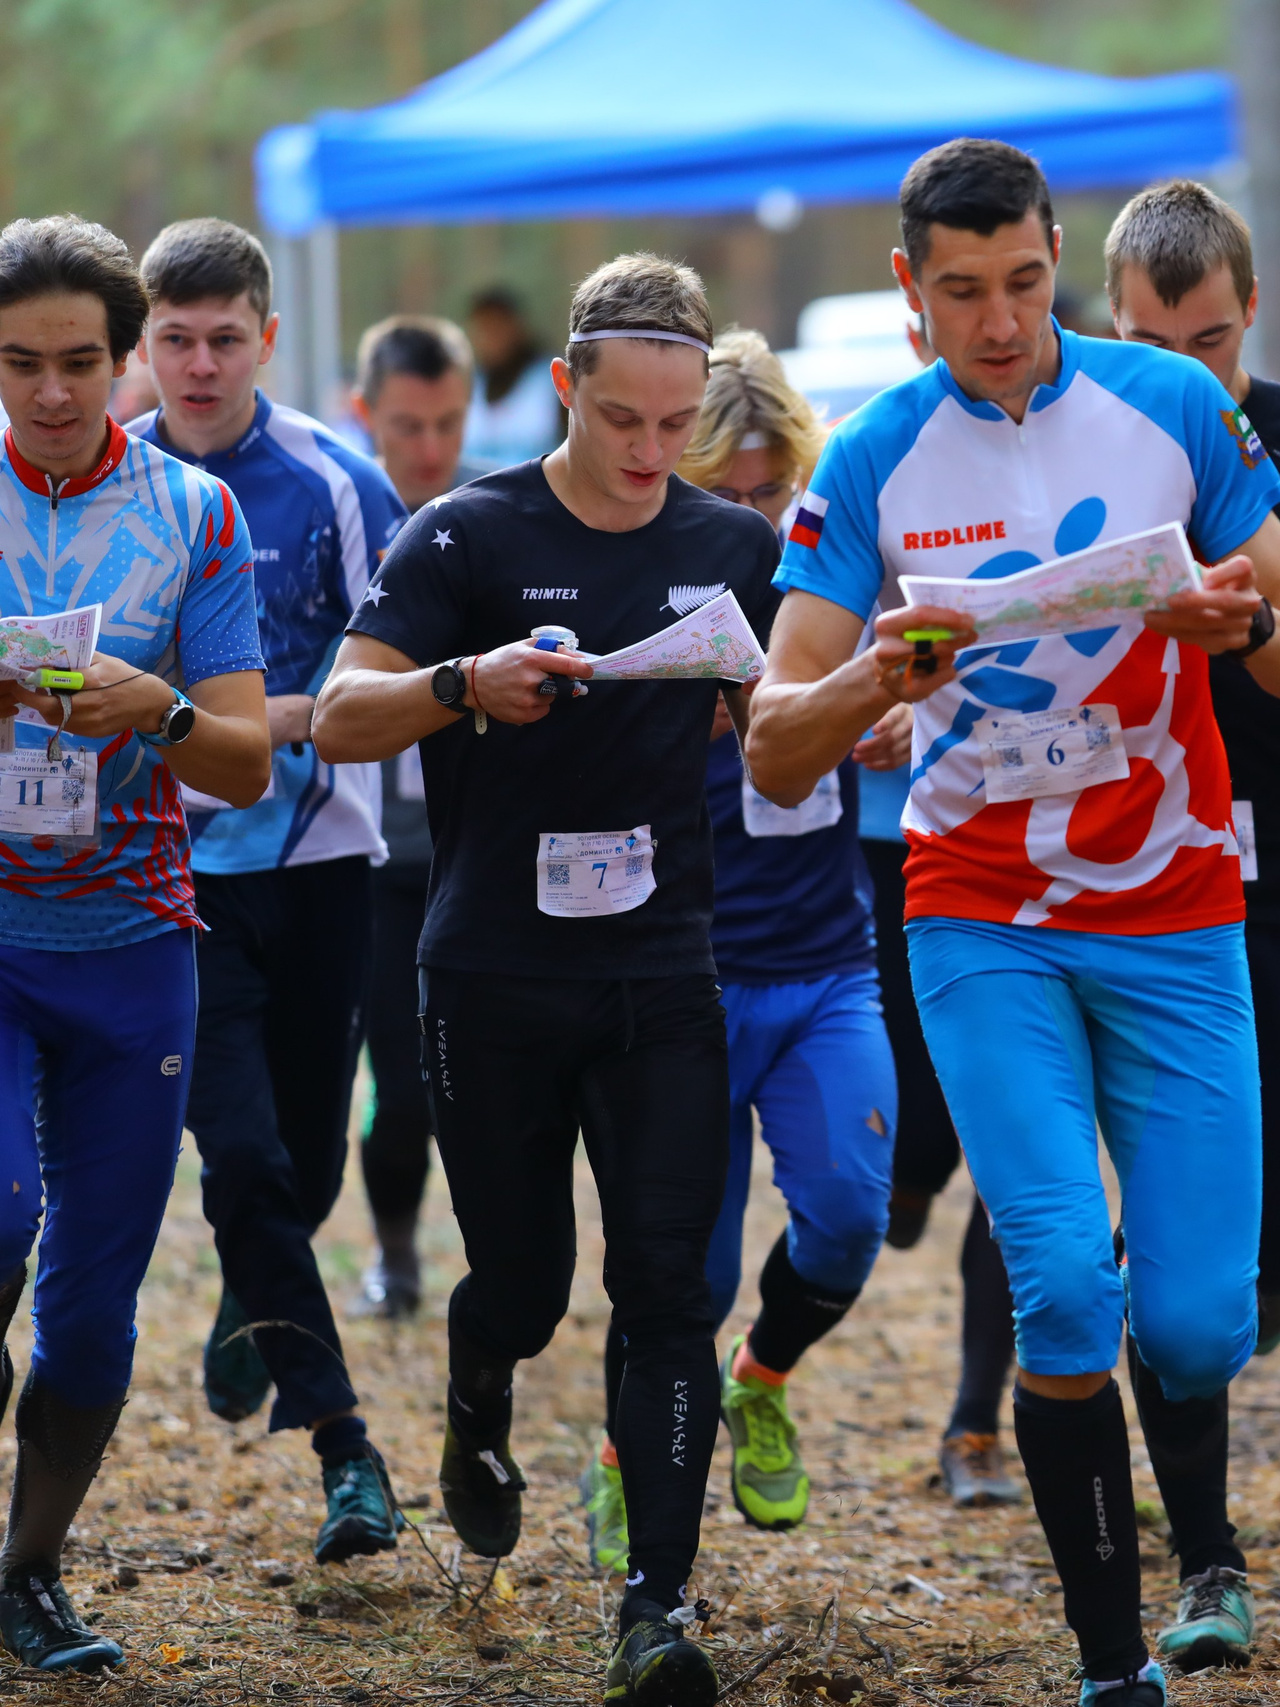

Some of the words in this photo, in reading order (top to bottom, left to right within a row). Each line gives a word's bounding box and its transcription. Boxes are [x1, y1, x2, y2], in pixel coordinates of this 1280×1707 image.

[903, 520, 1007, 551] REDLINE
[522, 588, 579, 600] TRIMTEX
[1046, 738, 1065, 766] 6
[15, 779, 45, 806] 11
[580, 849, 613, 857] ДОМИНТЕР
[591, 862, 608, 889] 7
[672, 1380, 688, 1467] ARSWEAR
[1093, 1476, 1108, 1537] NORD
